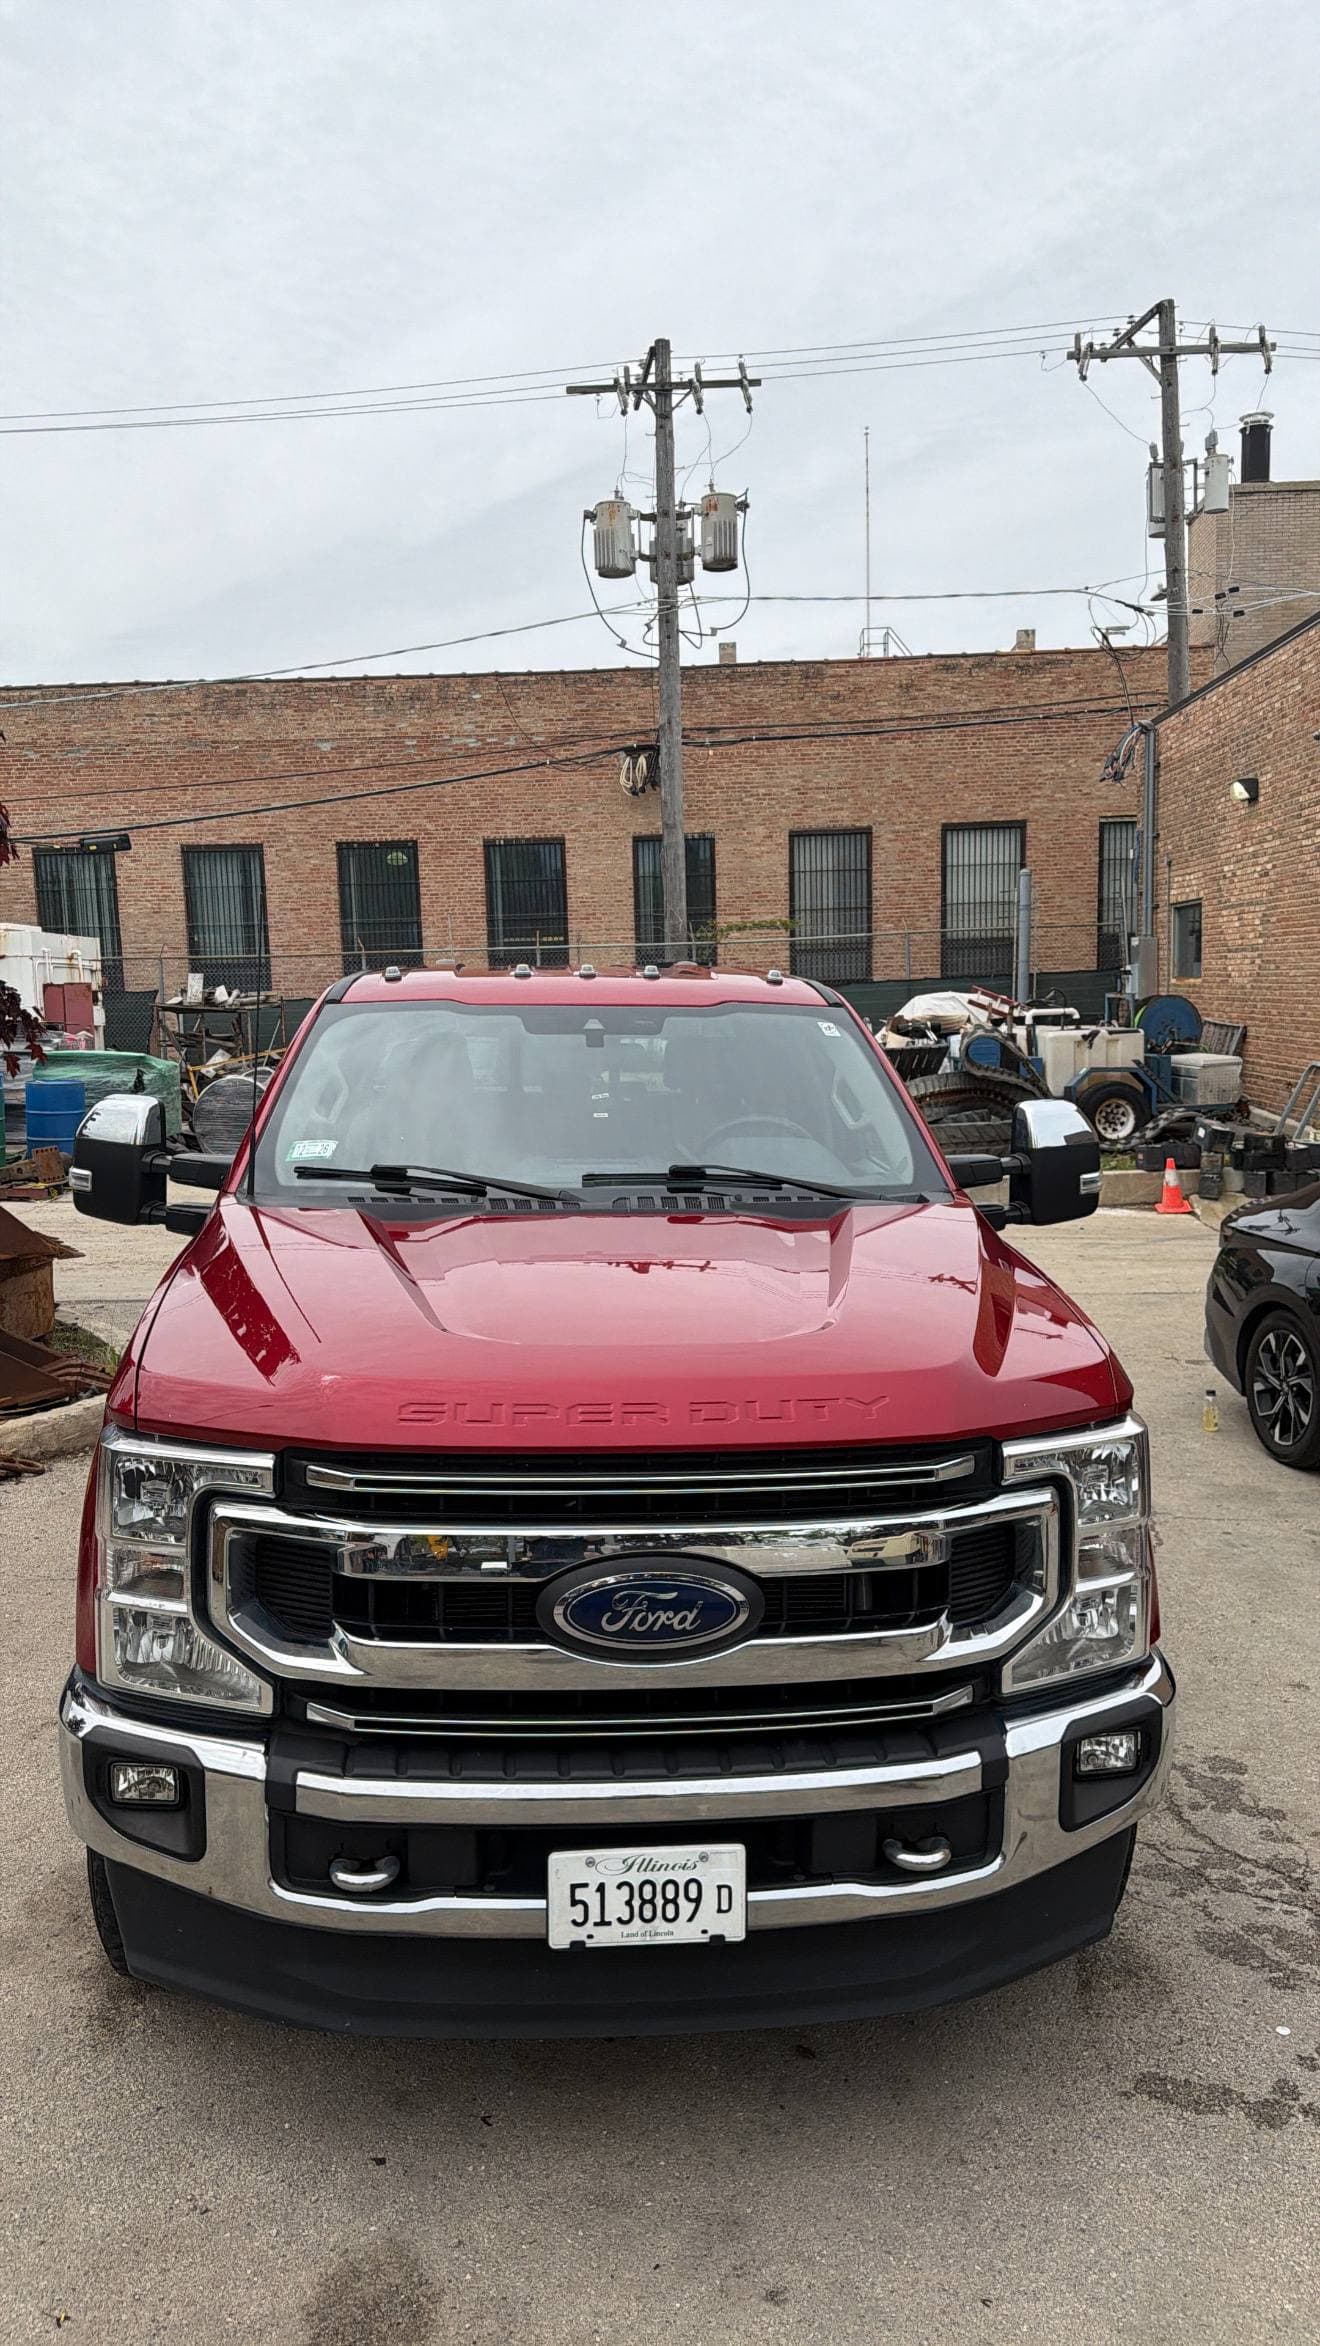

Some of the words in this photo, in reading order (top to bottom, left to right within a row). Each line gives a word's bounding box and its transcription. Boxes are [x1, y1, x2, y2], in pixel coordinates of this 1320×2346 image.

[398, 1401, 670, 1427] SUPER
[689, 1395, 890, 1426] DUTY
[600, 1590, 704, 1632] Ford
[595, 1853, 700, 1876] Illinois
[569, 1877, 703, 1928] 513889
[716, 1884, 733, 1914] D
[620, 1930, 639, 1939] Land
[640, 1929, 649, 1938] of
[649, 1928, 674, 1937] Lincoln
